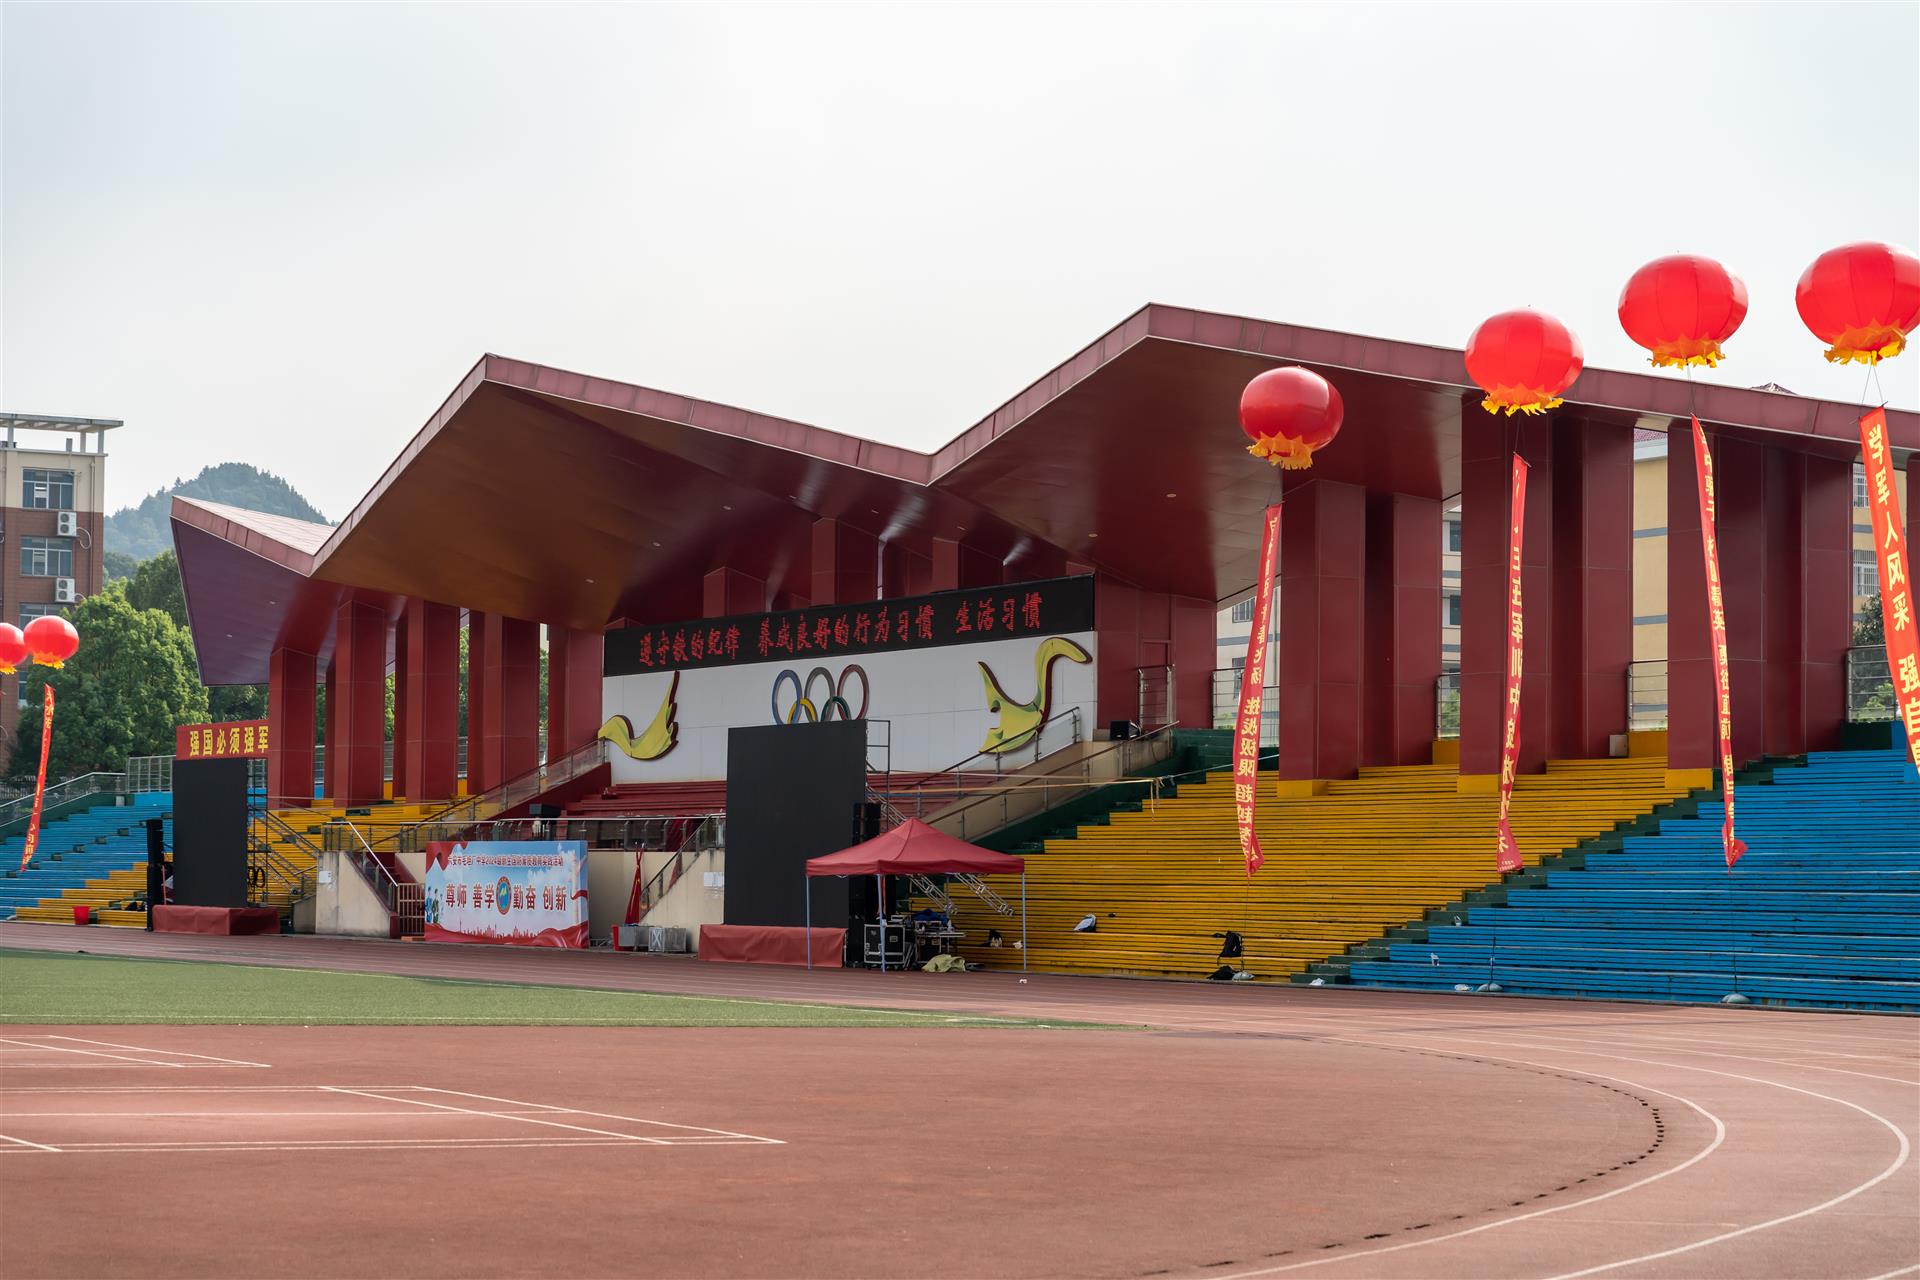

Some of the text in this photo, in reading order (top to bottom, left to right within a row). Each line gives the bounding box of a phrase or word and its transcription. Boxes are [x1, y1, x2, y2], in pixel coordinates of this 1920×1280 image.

[1867, 423, 1910, 633] 学军人风采
[955, 591, 1043, 634] 生活习惯
[189, 725, 269, 758] 强国必须强军
[446, 882, 467, 909] 尊师
[472, 882, 495, 910] 善学
[513, 884, 536, 911] 勤奋
[543, 885, 567, 911] 创新
